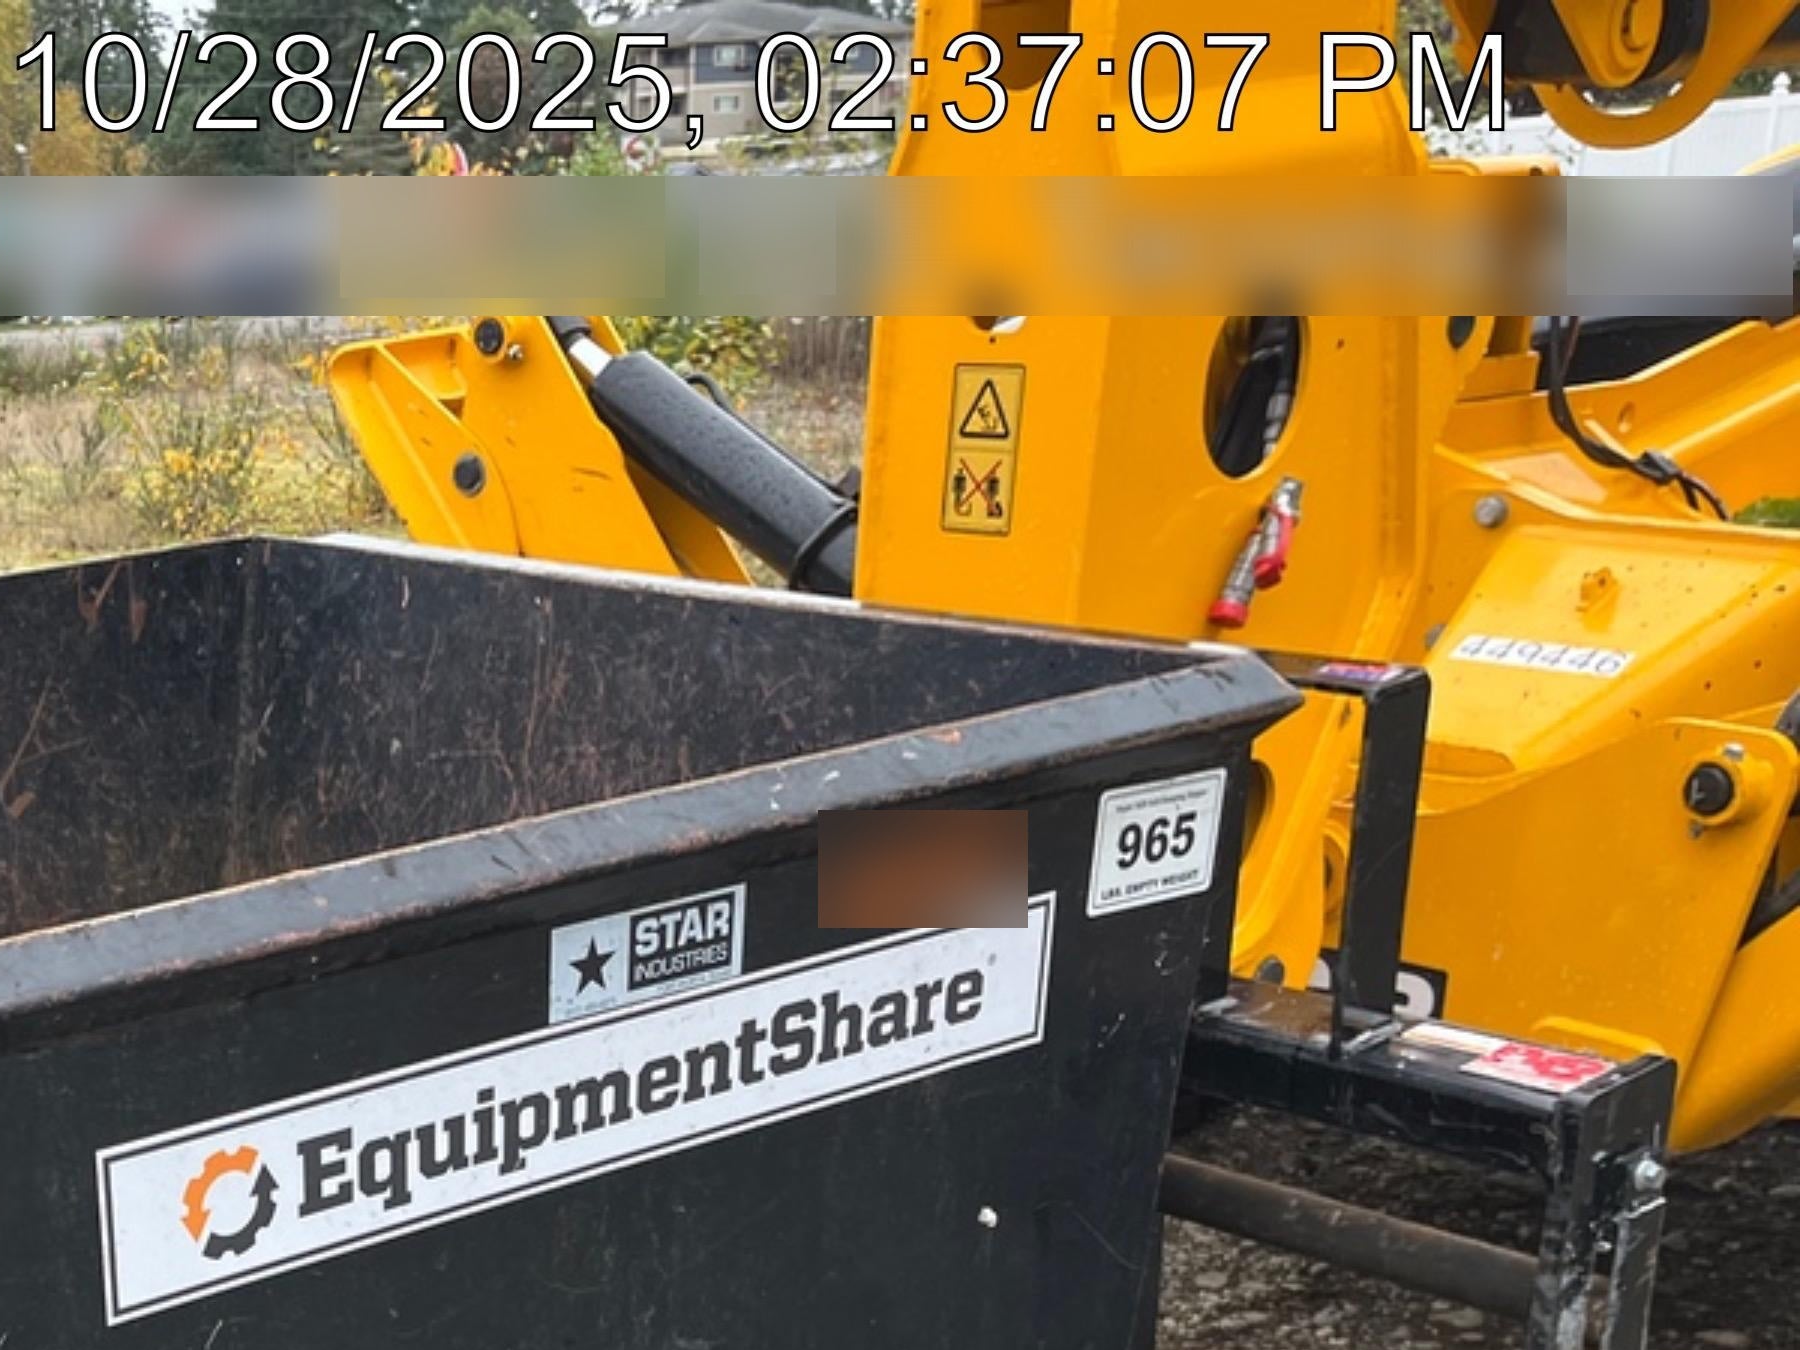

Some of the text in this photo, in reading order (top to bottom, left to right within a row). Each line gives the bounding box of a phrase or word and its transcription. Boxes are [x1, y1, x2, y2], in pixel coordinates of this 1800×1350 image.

[1460, 635, 1628, 673] 449446
[1116, 810, 1198, 870] 965
[1160, 869, 1199, 887] WEIGHT
[634, 900, 730, 957] STAR
[632, 941, 728, 982] INDUSTRIES
[296, 966, 985, 1218] EquipmentShare
